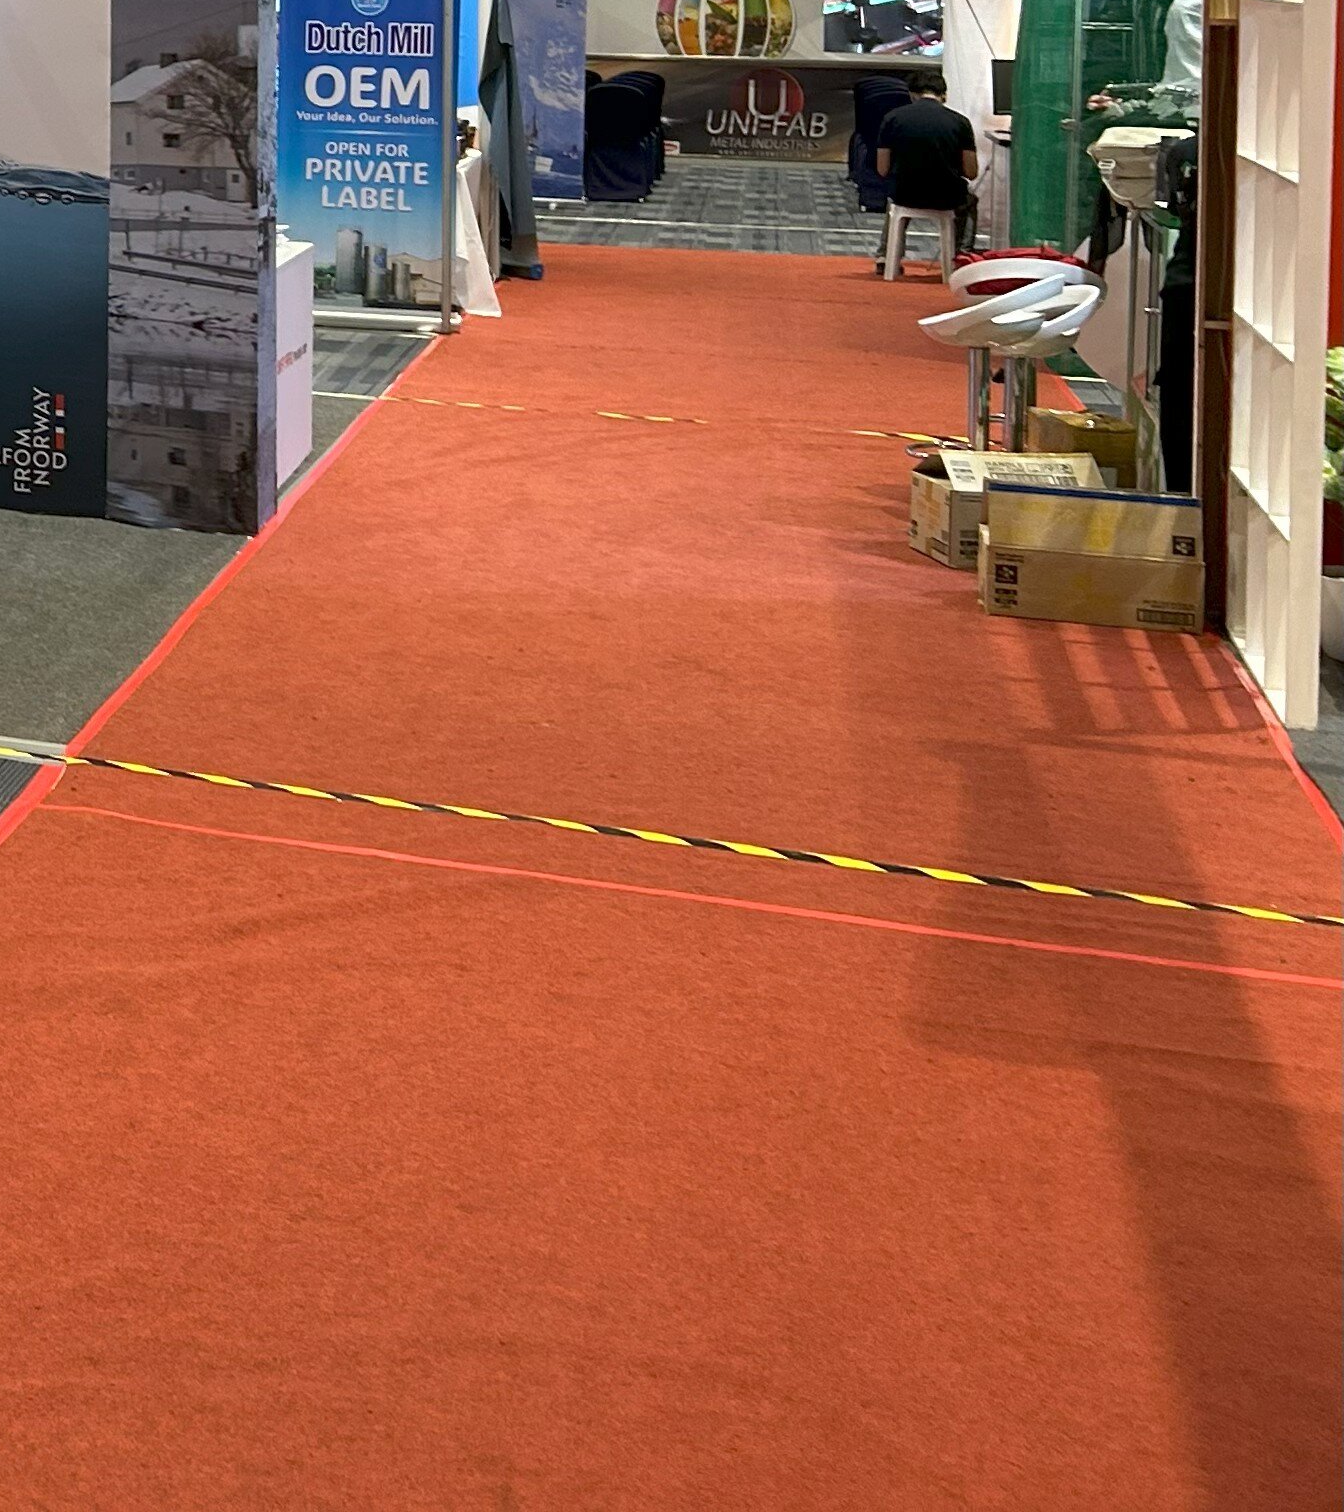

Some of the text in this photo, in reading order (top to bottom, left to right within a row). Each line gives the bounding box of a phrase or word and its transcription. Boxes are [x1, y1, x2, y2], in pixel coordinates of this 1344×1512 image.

[305, 20, 434, 57] Dutch Mill
[304, 64, 430, 110] OEM
[296, 110, 324, 121] Your
[359, 113, 382, 123] Our
[384, 113, 439, 126] Solution.
[325, 141, 410, 157] OPEN FOR
[305, 157, 430, 185] PRIVATE
[321, 185, 412, 212] LABEL
[32, 386, 51, 486] NORWAY
[13, 428, 32, 493] FROM
